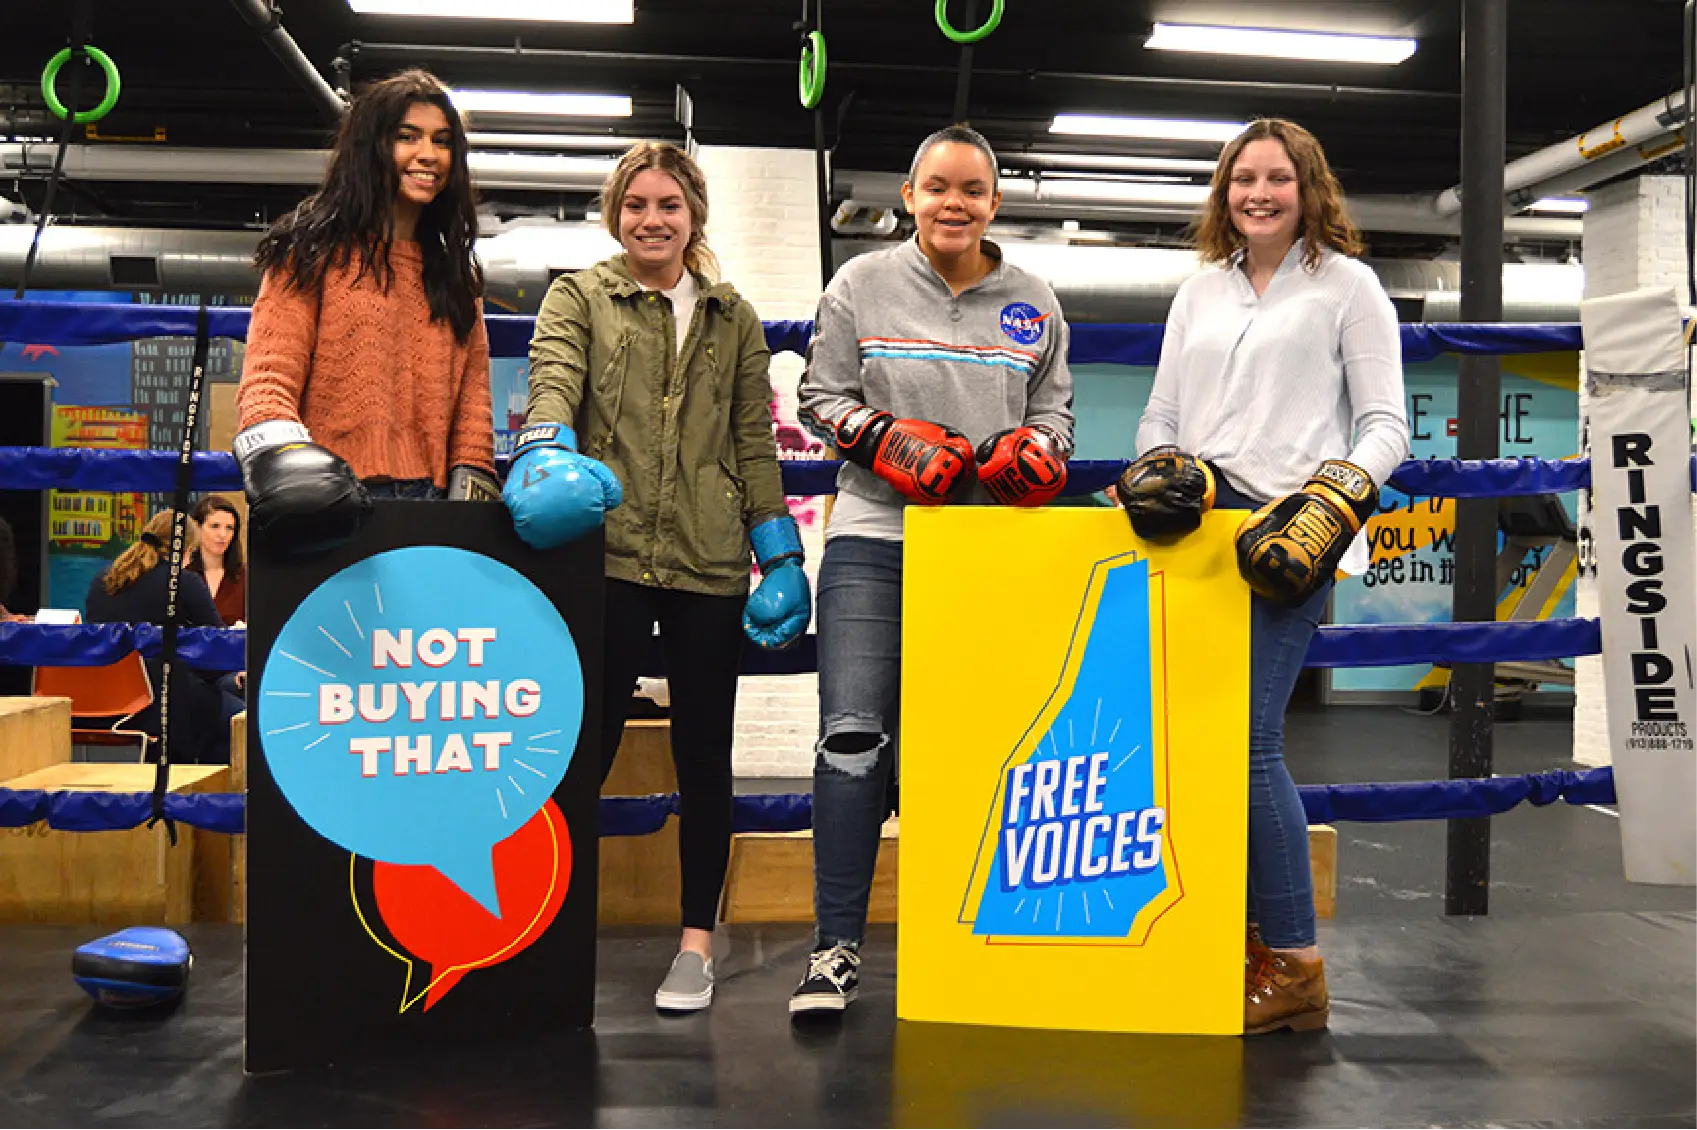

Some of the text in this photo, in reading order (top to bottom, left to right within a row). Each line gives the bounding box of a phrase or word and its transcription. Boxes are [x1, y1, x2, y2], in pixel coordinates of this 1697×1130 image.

[1002, 313, 1040, 333] NASA
[180, 365, 203, 464] RINGSIDE
[1411, 394, 1433, 441] E
[1500, 393, 1534, 444] HE
[166, 511, 186, 617] PRODUCTS
[1362, 557, 1405, 588] see
[1409, 552, 1435, 583] in
[1611, 432, 1679, 722] RINGSIDE
[371, 627, 497, 669] NOT
[318, 678, 542, 725] BUYING
[1631, 721, 1688, 737] PRODUCTS
[349, 730, 513, 778] THAT
[1003, 751, 1109, 824] FREE
[1001, 806, 1165, 892] VOICES
